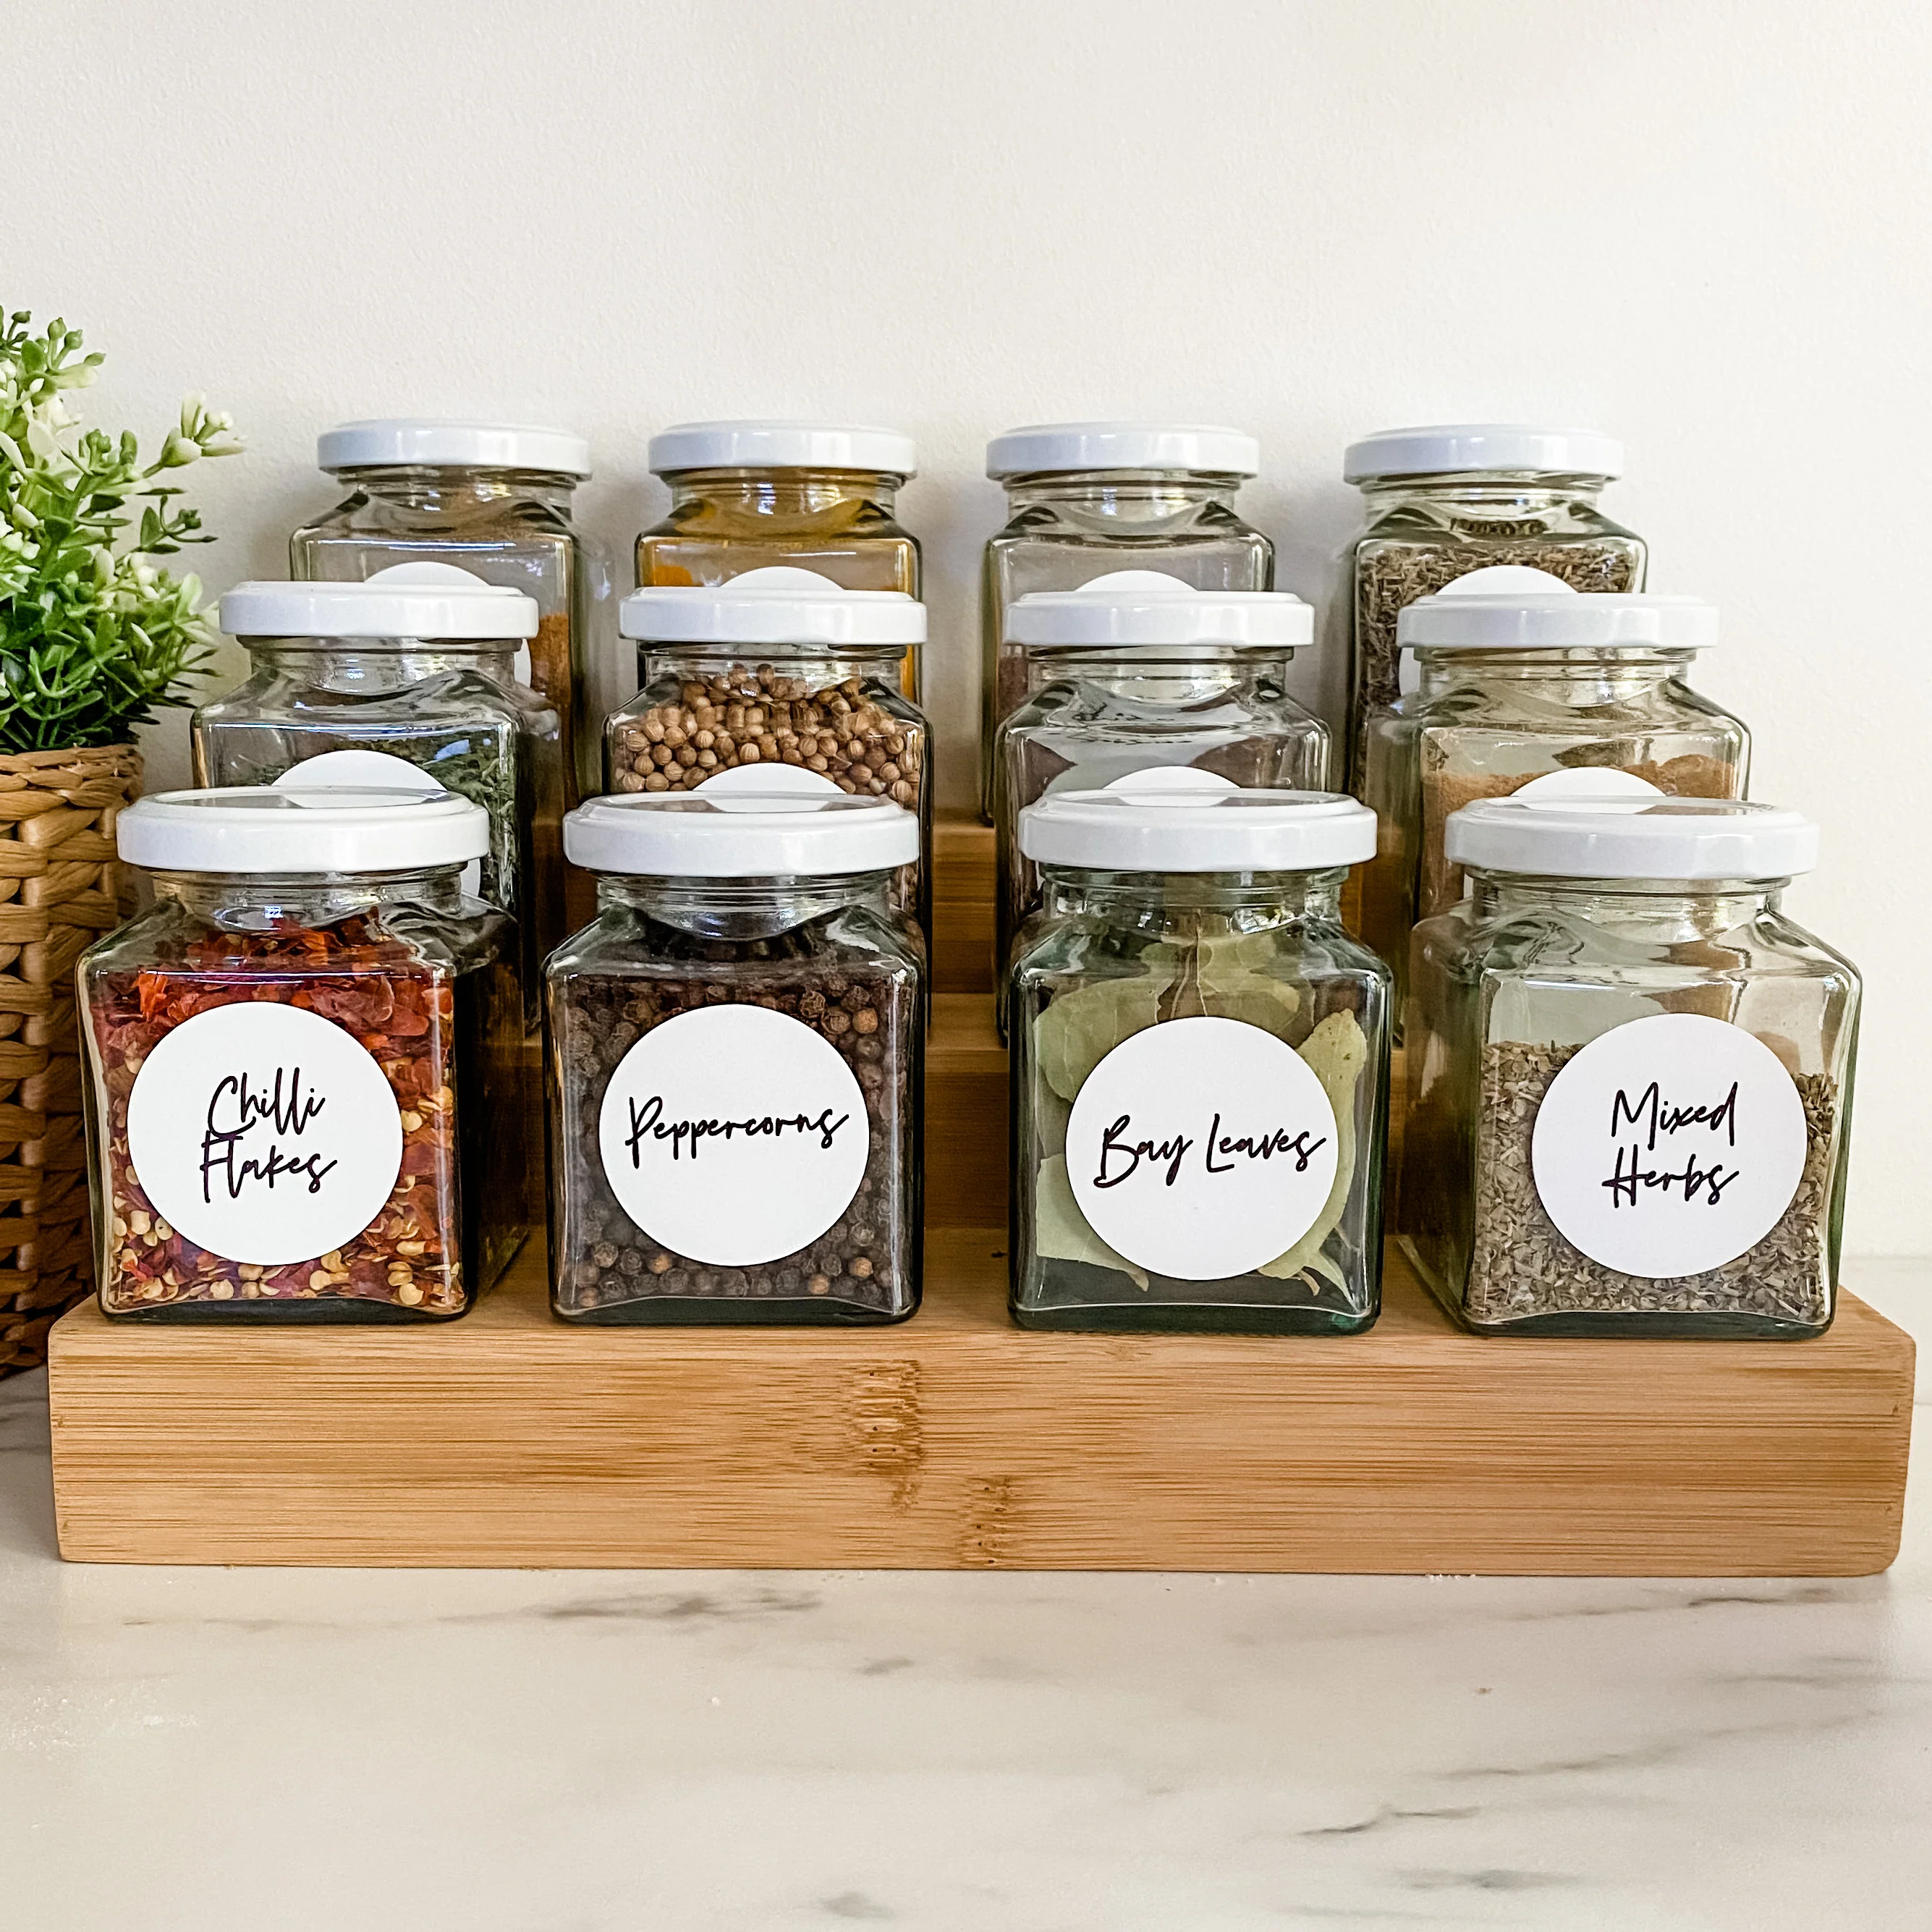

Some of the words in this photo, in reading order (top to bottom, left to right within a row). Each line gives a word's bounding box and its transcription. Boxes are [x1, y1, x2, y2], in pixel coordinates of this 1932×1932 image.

[207, 1067, 326, 1137] Chilli
[624, 1096, 850, 1170] Peppercorns
[1611, 1081, 1738, 1151] Mixed
[199, 1130, 338, 1204] Flakes
[1093, 1114, 1194, 1189] Bay
[1206, 1113, 1327, 1173] Leaves
[1601, 1144, 1740, 1209] Herbs
